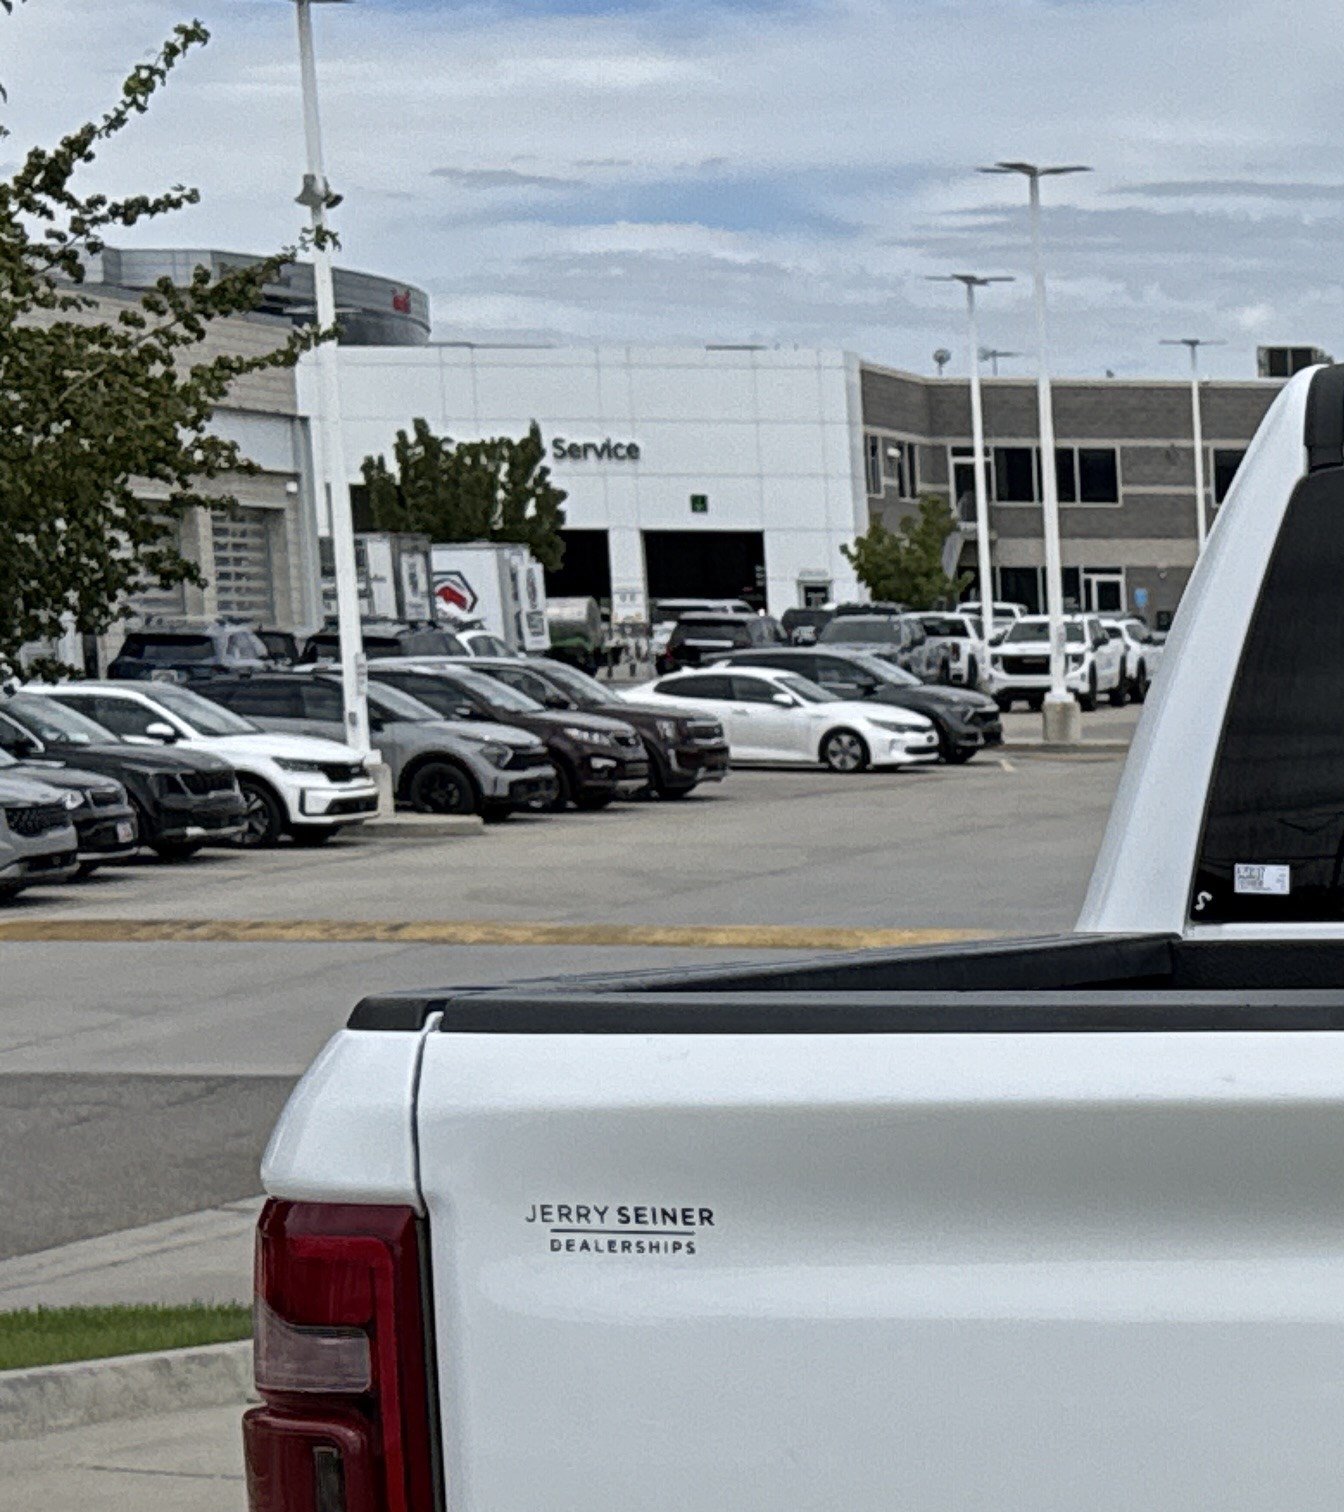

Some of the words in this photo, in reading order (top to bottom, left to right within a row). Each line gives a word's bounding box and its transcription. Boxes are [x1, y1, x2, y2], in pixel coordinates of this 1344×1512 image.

[552, 437, 640, 460] Service
[525, 1204, 609, 1224] JERRY
[616, 1206, 715, 1226] SEINER
[550, 1239, 696, 1254] DEALERSHIPS
